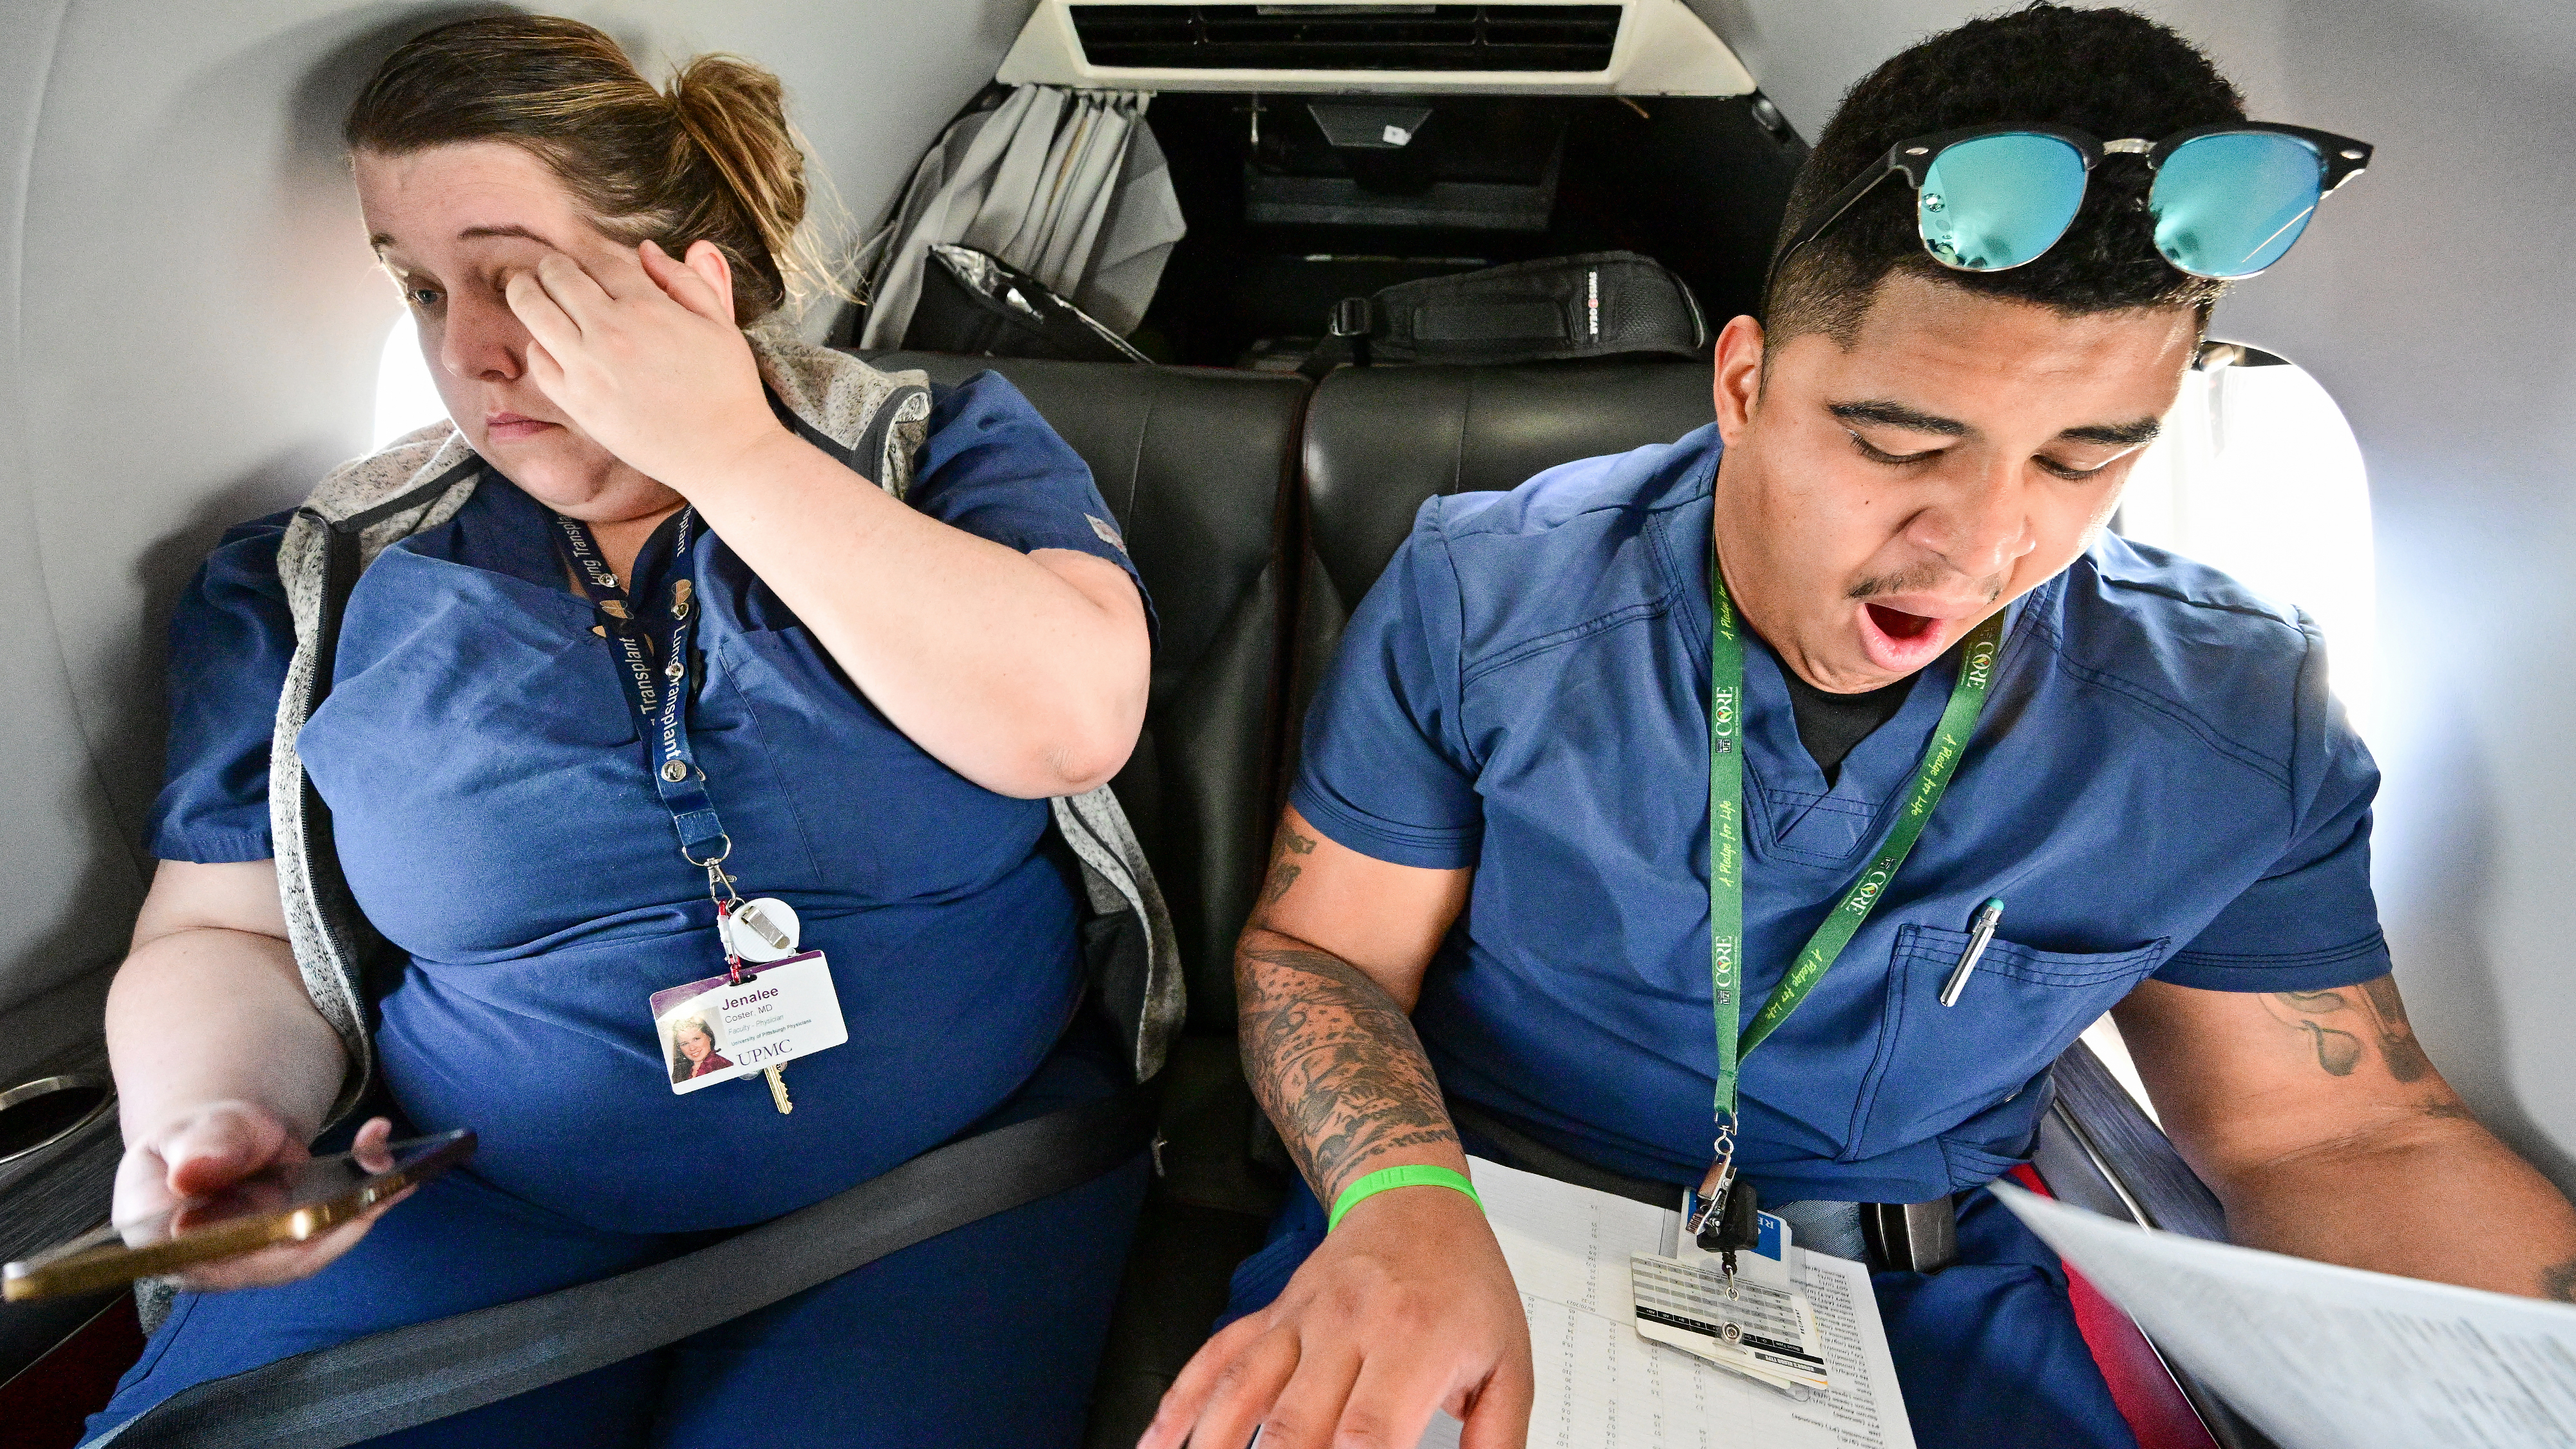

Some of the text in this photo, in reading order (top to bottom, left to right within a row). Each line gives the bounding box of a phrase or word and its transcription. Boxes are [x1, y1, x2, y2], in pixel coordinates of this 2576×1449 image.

[677, 504, 694, 558] nsplant
[1720, 601, 1733, 628] Pledge
[1721, 630, 1735, 641] A
[618, 637, 658, 715] Transplant
[1966, 641, 1994, 690] CORE
[661, 681, 682, 761] ransplant
[1715, 686, 1734, 737] CORE
[1911, 733, 1956, 816] A Pledge for Life
[1719, 800, 1737, 887] A Pledge for Life
[1846, 871, 1886, 916] CORE
[1715, 935, 1732, 987] CORE
[1810, 948, 1823, 962] A
[1792, 960, 1817, 987] Pledge
[722, 988, 779, 1010] Jenalee
[1781, 983, 1795, 1003] for
[758, 1004, 773, 1014] MD
[728, 1023, 751, 1036] Faculty
[755, 1014, 784, 1028] Physician
[731, 1036, 755, 1046] University
[762, 1026, 786, 1037] Pittsburgh
[786, 1019, 812, 1030] Physicians
[736, 1039, 793, 1066] UPMC
[1795, 1309, 1805, 1335] RECIPIENT
